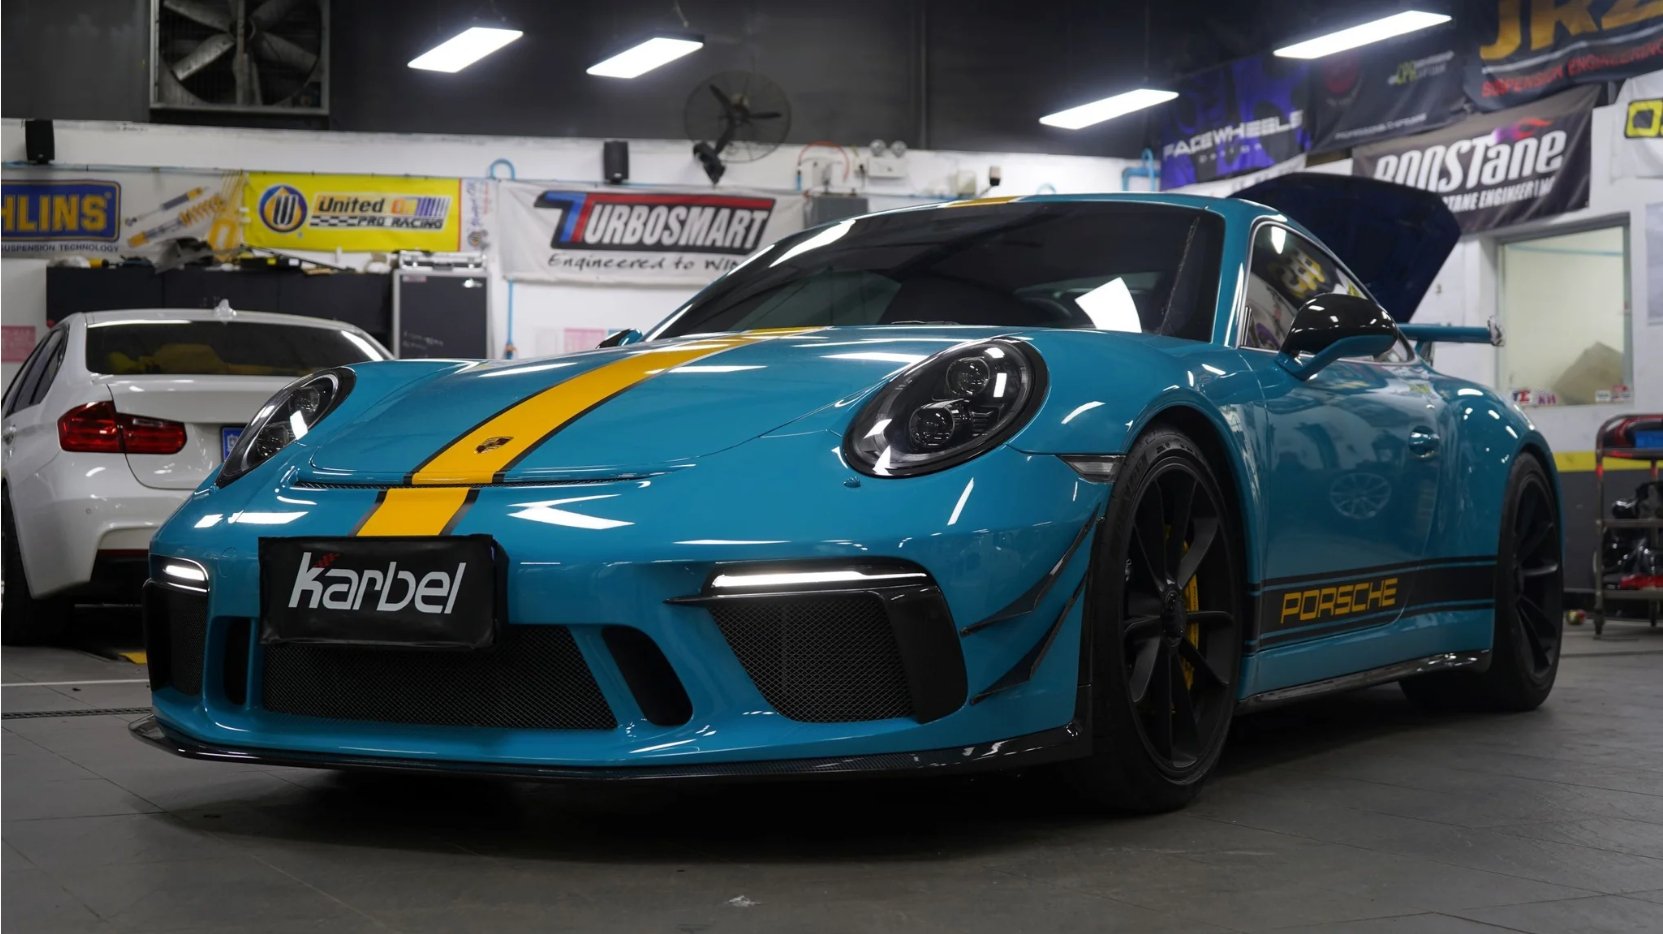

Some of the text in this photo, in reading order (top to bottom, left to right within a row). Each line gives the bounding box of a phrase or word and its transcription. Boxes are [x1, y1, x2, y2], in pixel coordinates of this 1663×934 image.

[318, 197, 386, 214] United
[357, 216, 444, 229] PRO RACING
[540, 190, 776, 252] TURBOSMART
[60, 243, 119, 253] TECHNOLOGY
[547, 253, 666, 274] Engineered
[675, 256, 695, 271] to
[288, 552, 467, 614] karbel
[1280, 578, 1398, 624] PORSCHE
